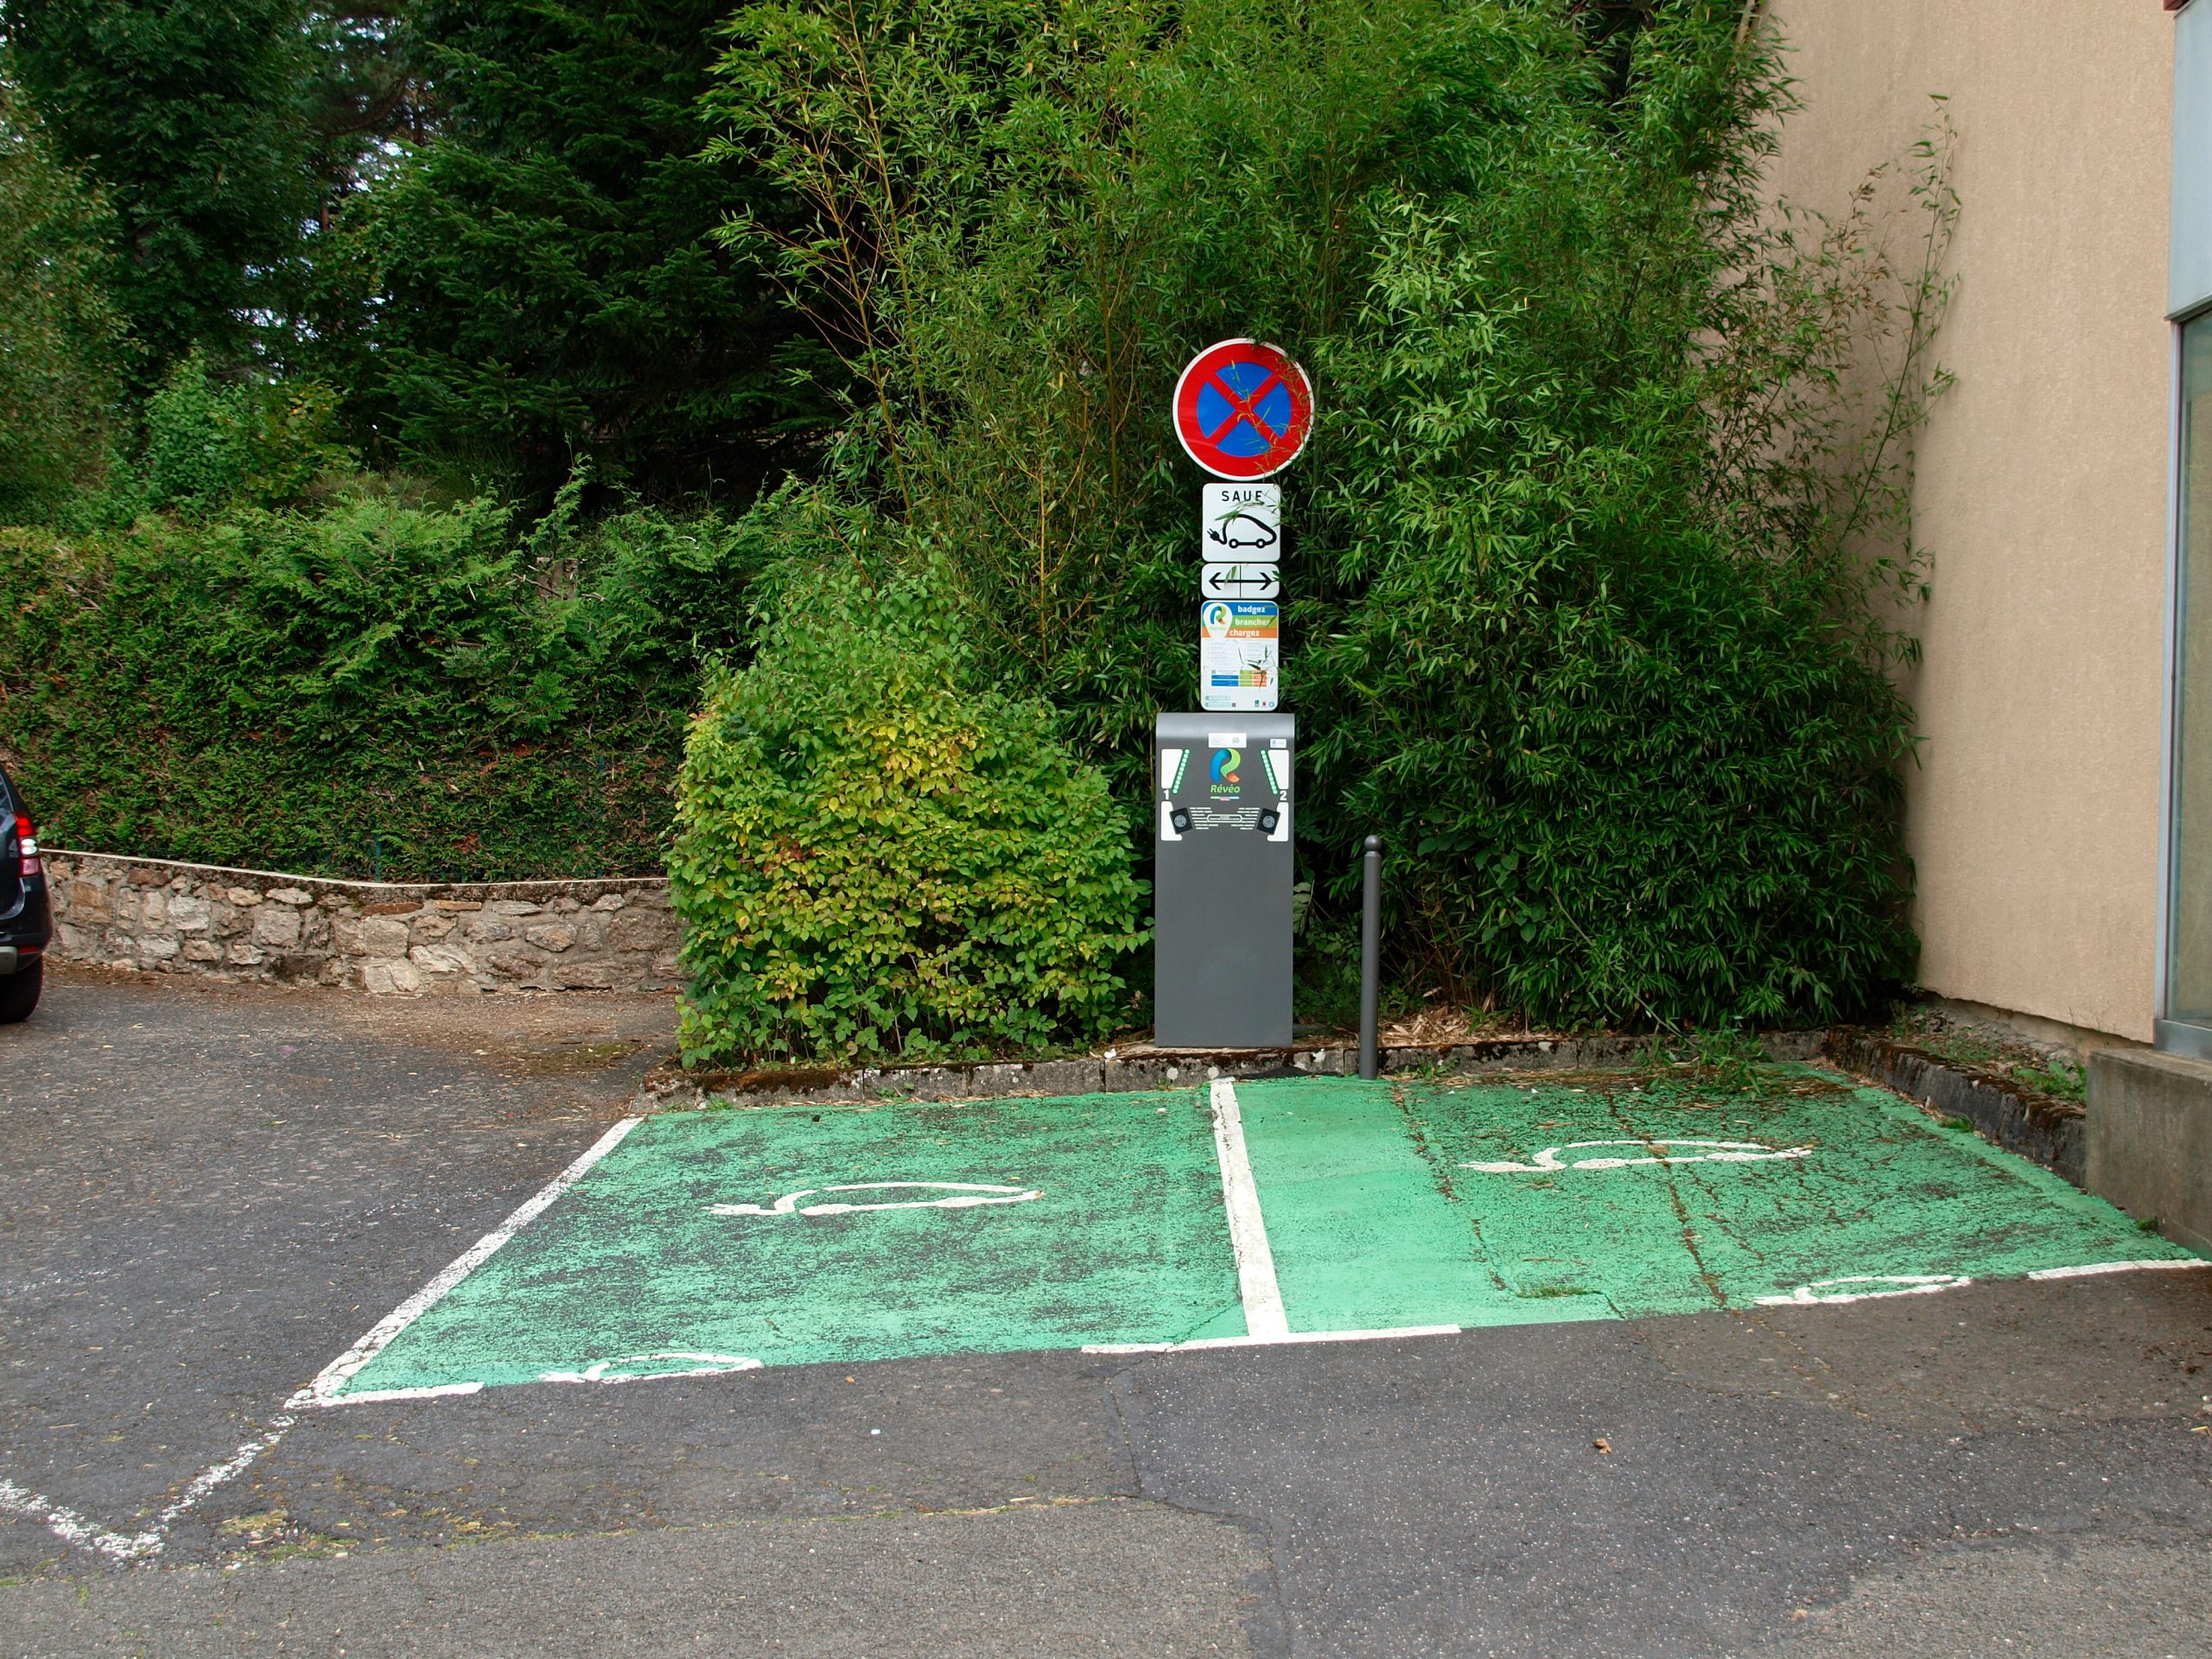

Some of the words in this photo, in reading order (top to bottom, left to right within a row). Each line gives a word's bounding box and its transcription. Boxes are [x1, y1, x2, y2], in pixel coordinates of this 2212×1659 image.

[1221, 490, 1263, 502] SAUF
[1237, 605, 1266, 615] badgez
[1235, 618, 1271, 626] branchez
[1229, 629, 1261, 638] chargez
[1210, 784, 1241, 793] Révéo
[1163, 789, 1169, 800] 1
[1279, 790, 1287, 801] 2
